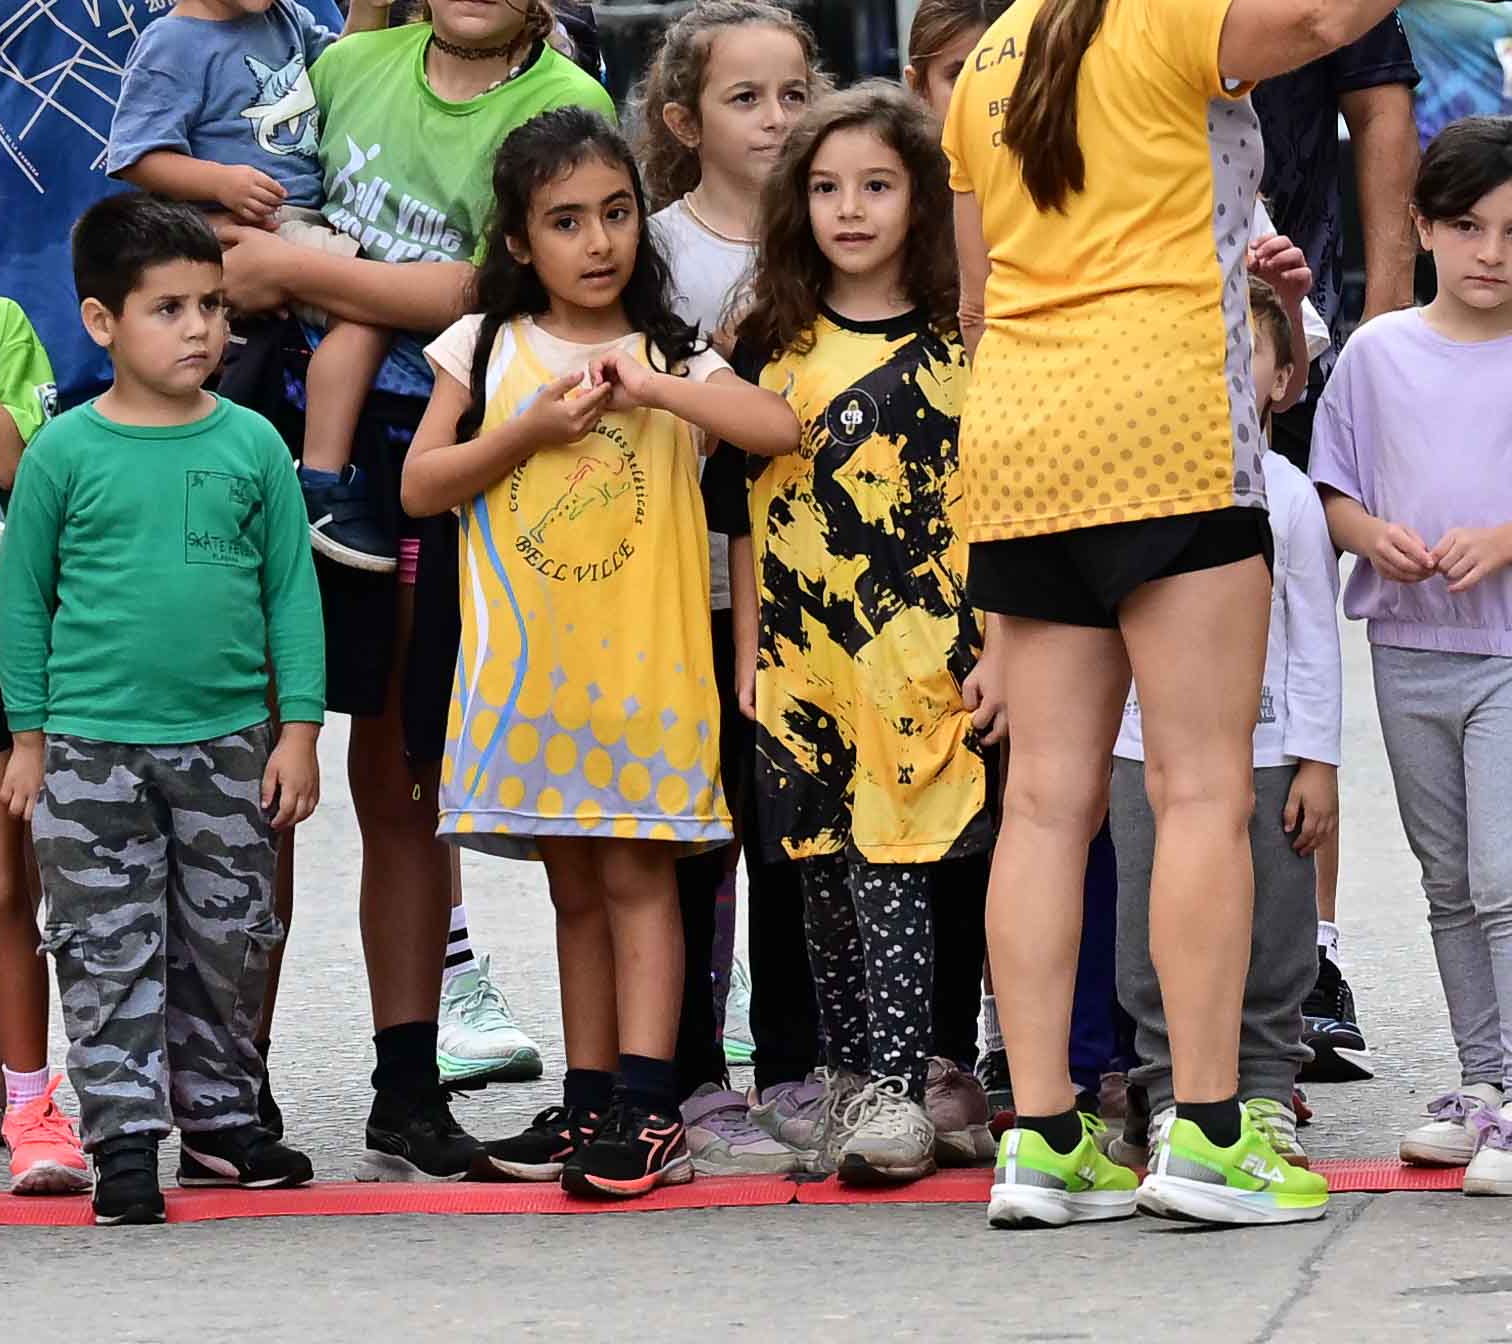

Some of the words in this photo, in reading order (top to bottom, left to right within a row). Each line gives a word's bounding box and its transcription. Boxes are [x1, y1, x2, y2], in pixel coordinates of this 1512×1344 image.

[516, 536, 569, 582] BELL
[573, 538, 635, 583] VILLE
[1239, 1154, 1285, 1183] FILA
